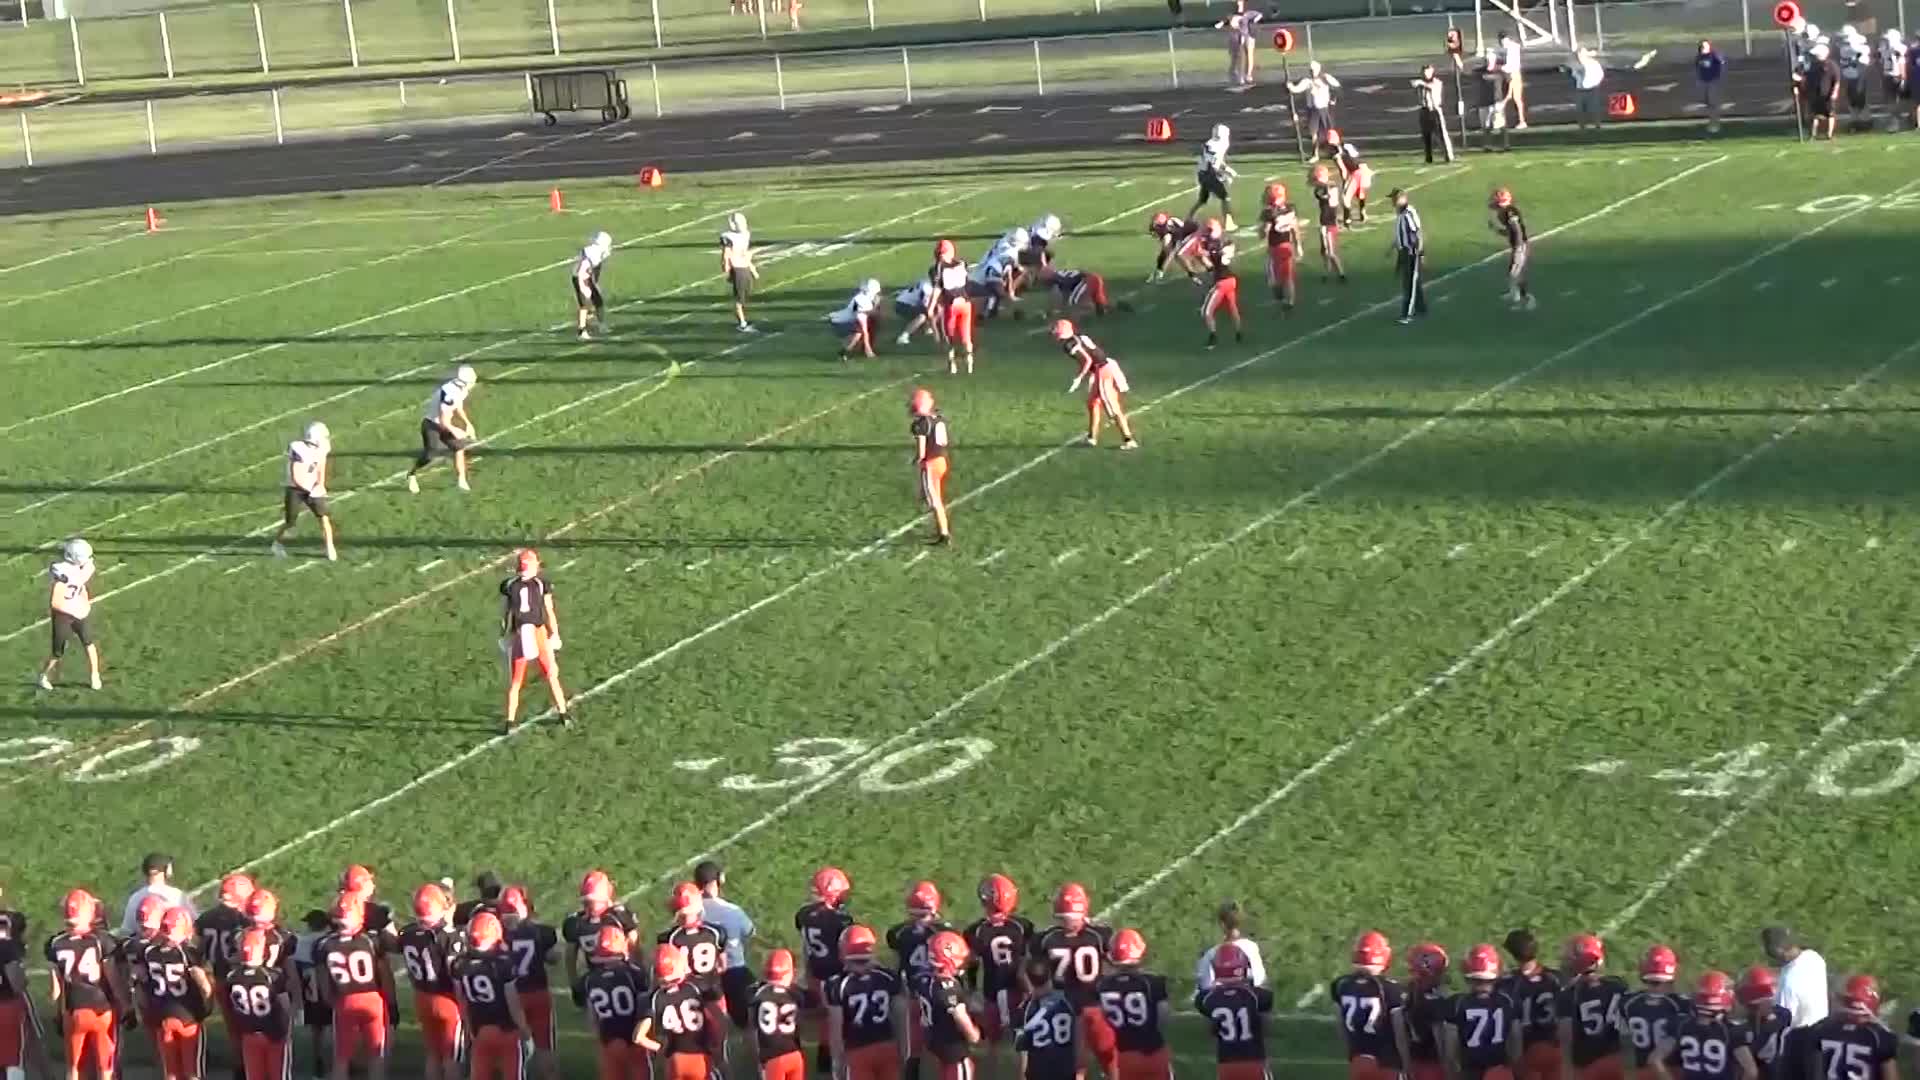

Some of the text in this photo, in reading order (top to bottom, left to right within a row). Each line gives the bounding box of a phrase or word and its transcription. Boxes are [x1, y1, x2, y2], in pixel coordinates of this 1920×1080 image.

[519, 587, 530, 613] 1
[719, 737, 996, 793] 30
[55, 947, 101, 983] 74
[327, 949, 374, 984] 60
[403, 945, 435, 981] 61
[990, 935, 1012, 965] 6
[1050, 945, 1100, 982] 70
[462, 975, 496, 1003] 19
[589, 985, 634, 1018] 20
[662, 998, 704, 1034] 46
[849, 990, 890, 1025] 73
[1101, 990, 1148, 1027] 59
[1211, 1006, 1254, 1041] 31
[1340, 996, 1381, 1034] 77
[1580, 993, 1630, 1036] 54
[1465, 1007, 1505, 1047] 71
[1680, 1036, 1727, 1073] 29
[1820, 1039, 1872, 1080] 75
